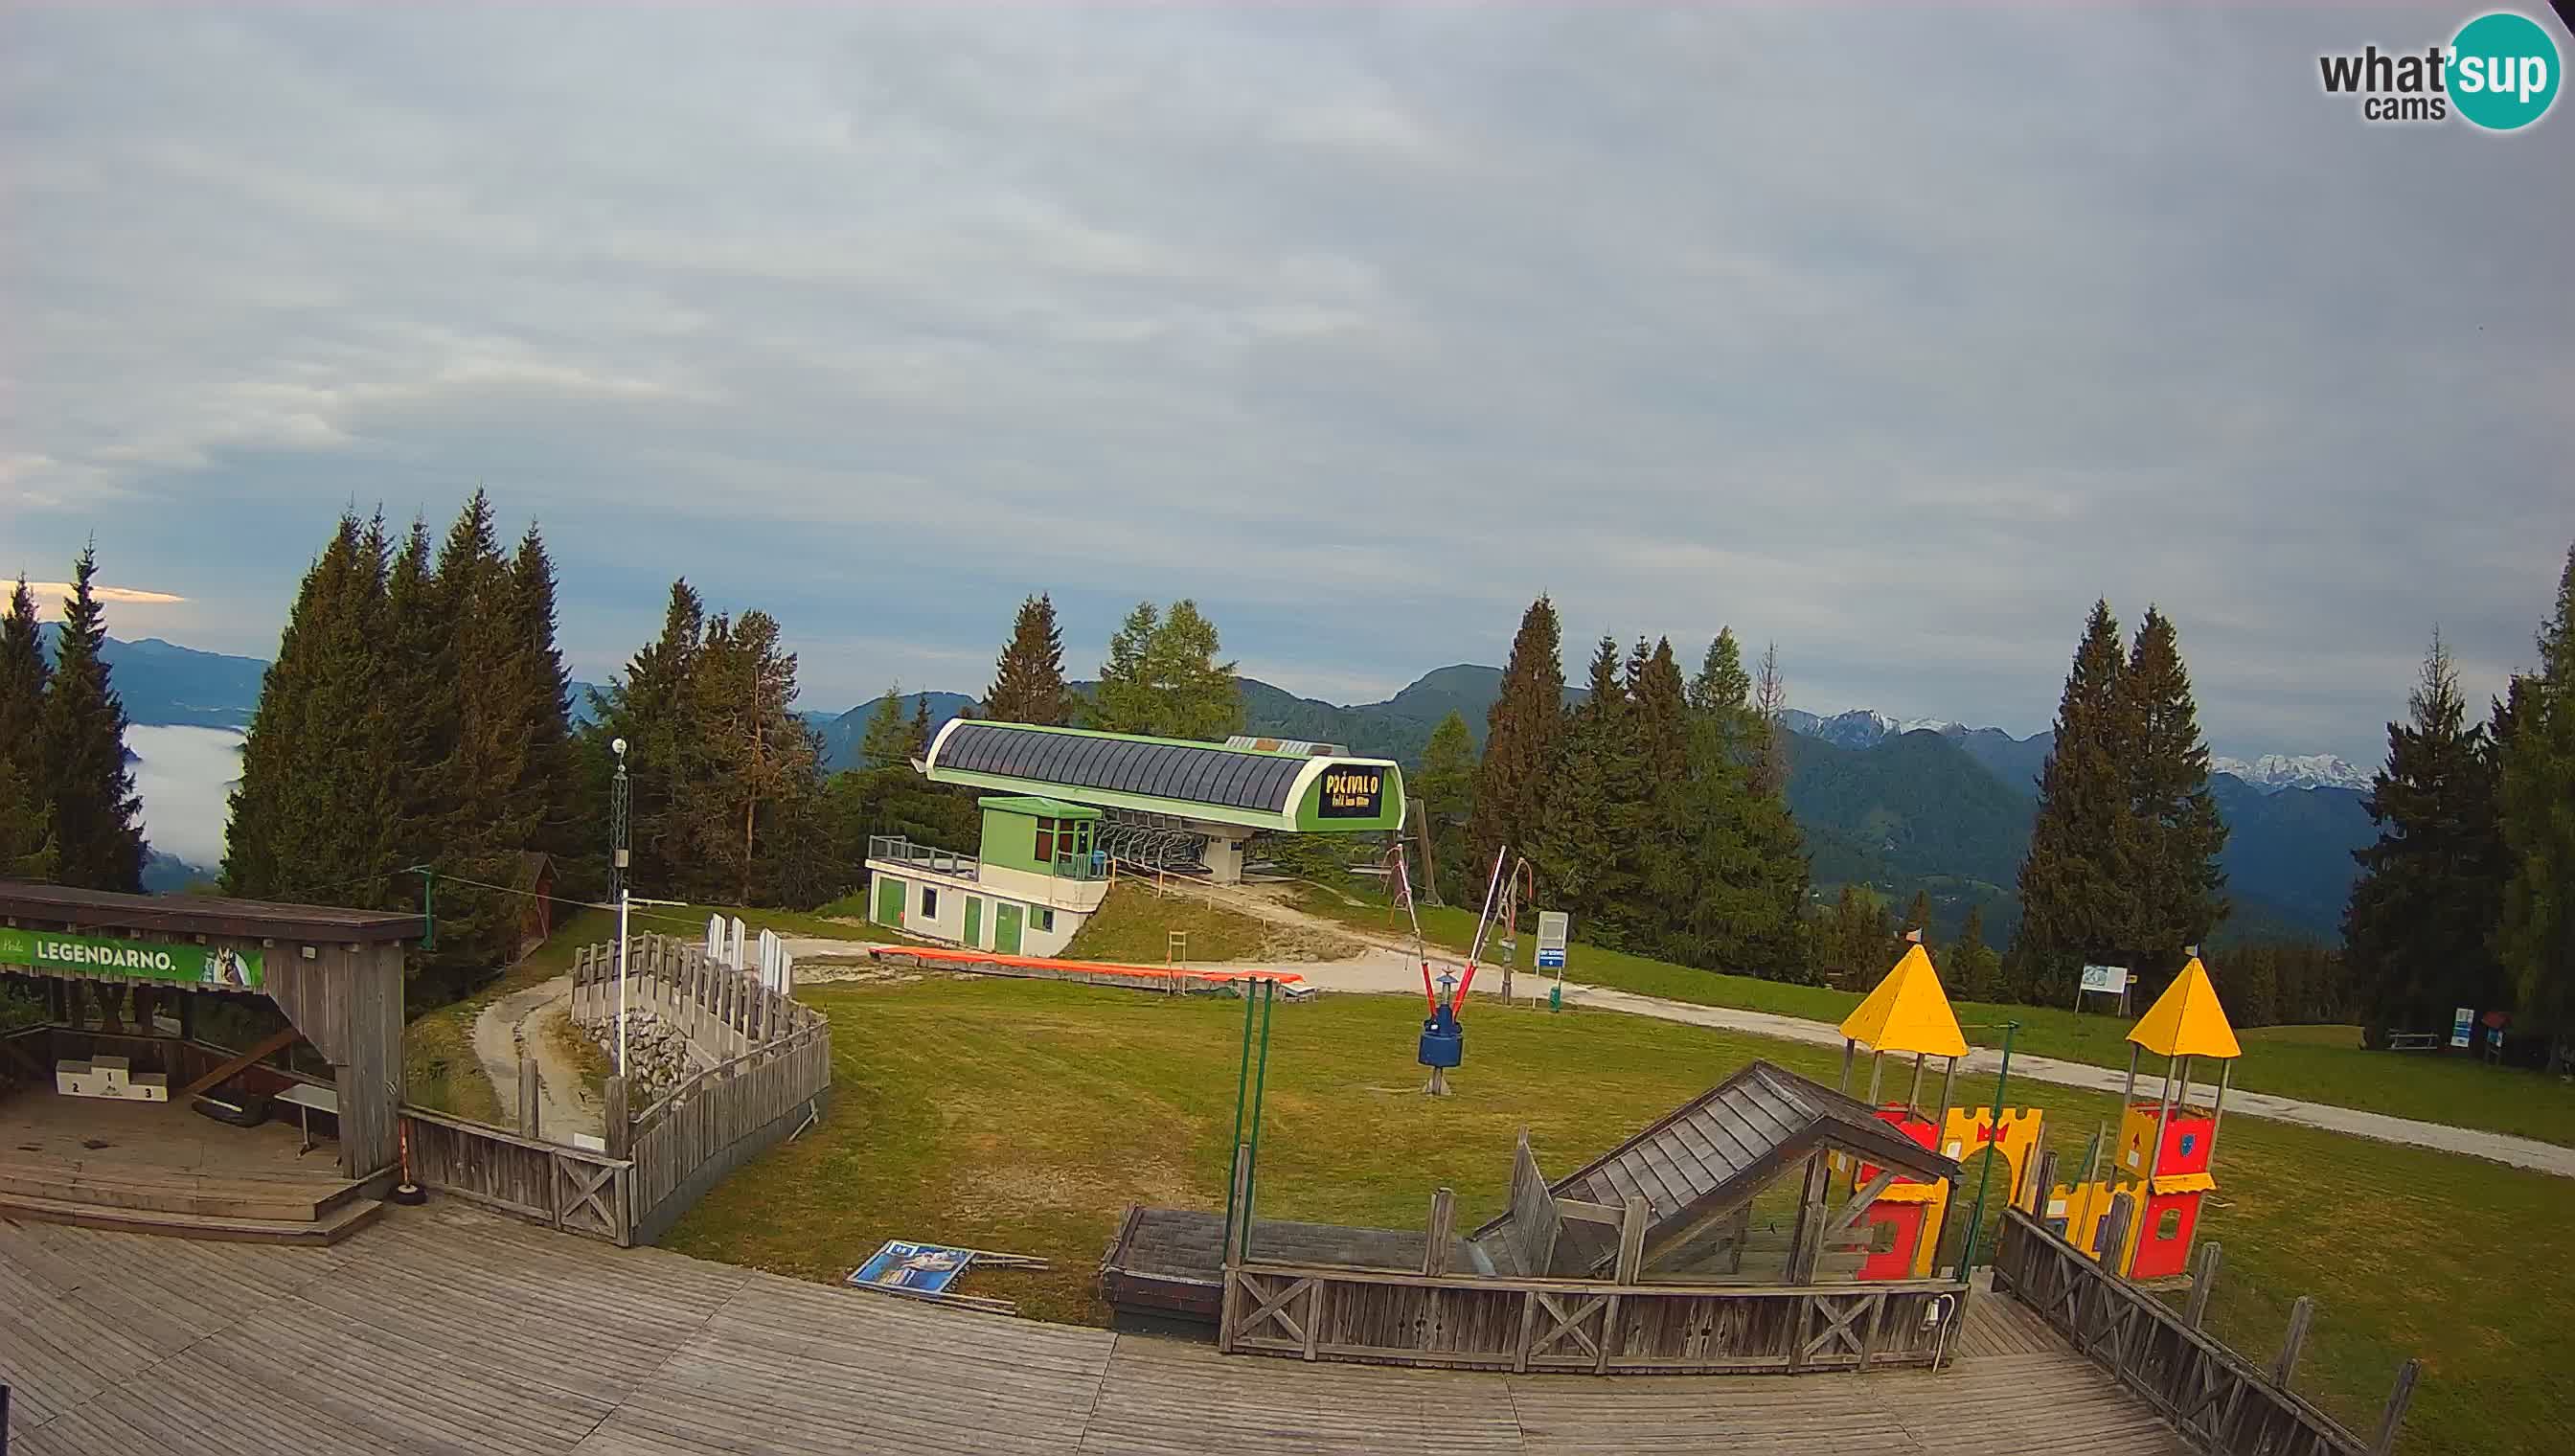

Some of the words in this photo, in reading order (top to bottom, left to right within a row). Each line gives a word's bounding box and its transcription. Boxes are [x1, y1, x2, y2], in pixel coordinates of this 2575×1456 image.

[36, 940, 177, 971] LEGENDARNO.
[72, 1082, 80, 1093] 2
[145, 1088, 152, 1099] 3
